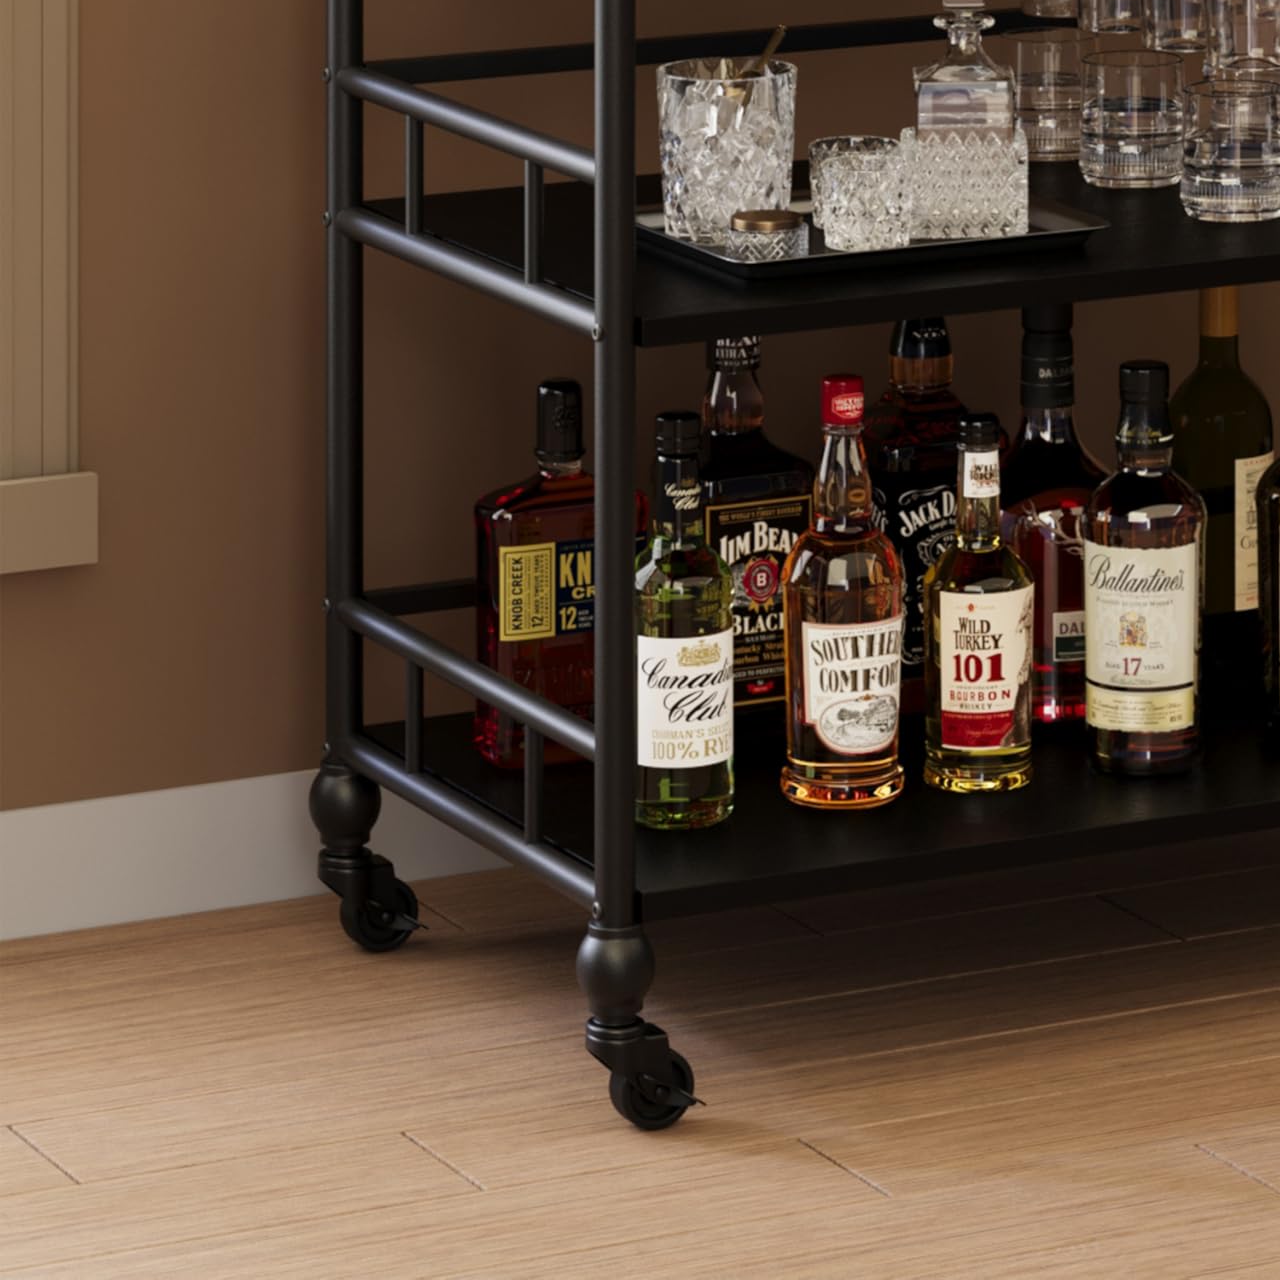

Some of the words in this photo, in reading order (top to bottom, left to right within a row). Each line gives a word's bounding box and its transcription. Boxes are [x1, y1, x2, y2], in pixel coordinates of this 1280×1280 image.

[898, 499, 941, 537] JACK
[719, 531, 751, 566] JIM
[512, 557, 523, 596] CREEK
[560, 550, 592, 588] KN
[512, 598, 523, 630] KNOB
[531, 615, 544, 628] 12
[559, 606, 577, 630] 12
[958, 617, 991, 634] WILD
[953, 630, 1003, 652] TURKEY
[953, 653, 1006, 683] 101
[1123, 657, 1142, 676] 17
[949, 689, 1011, 701] BOURBON
[653, 741, 699, 760] 100%
